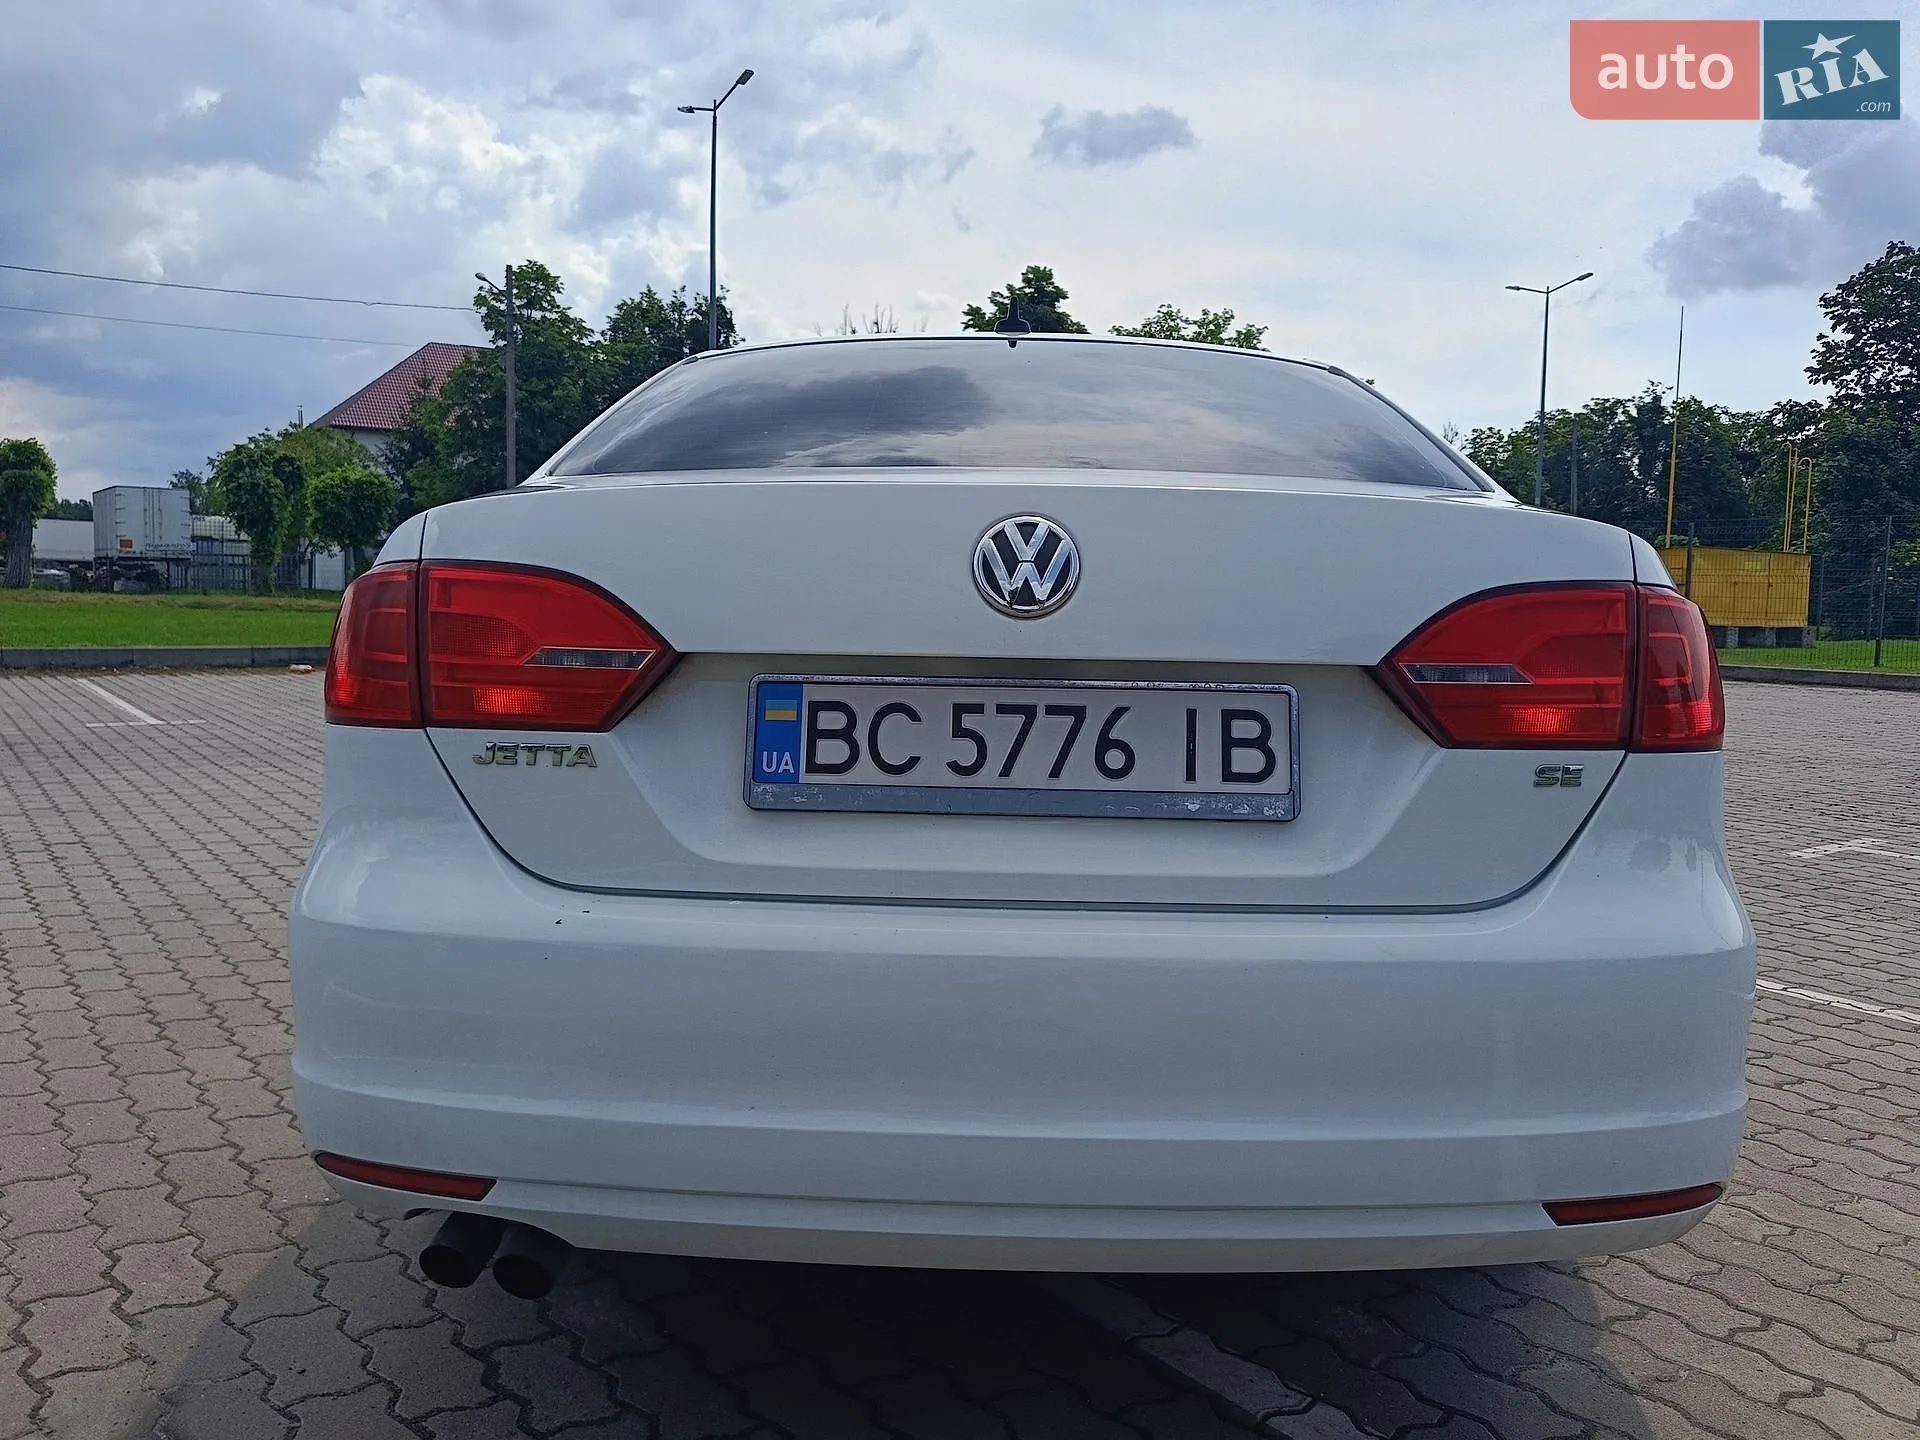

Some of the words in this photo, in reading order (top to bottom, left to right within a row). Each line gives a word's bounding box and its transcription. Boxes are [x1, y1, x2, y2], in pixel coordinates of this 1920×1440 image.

[804, 700, 922, 775] BC
[946, 704, 1136, 780] 5776
[1185, 708, 1277, 783] IB
[472, 742, 598, 767] JETTA
[761, 750, 795, 774] UA
[1533, 764, 1584, 787] SE
